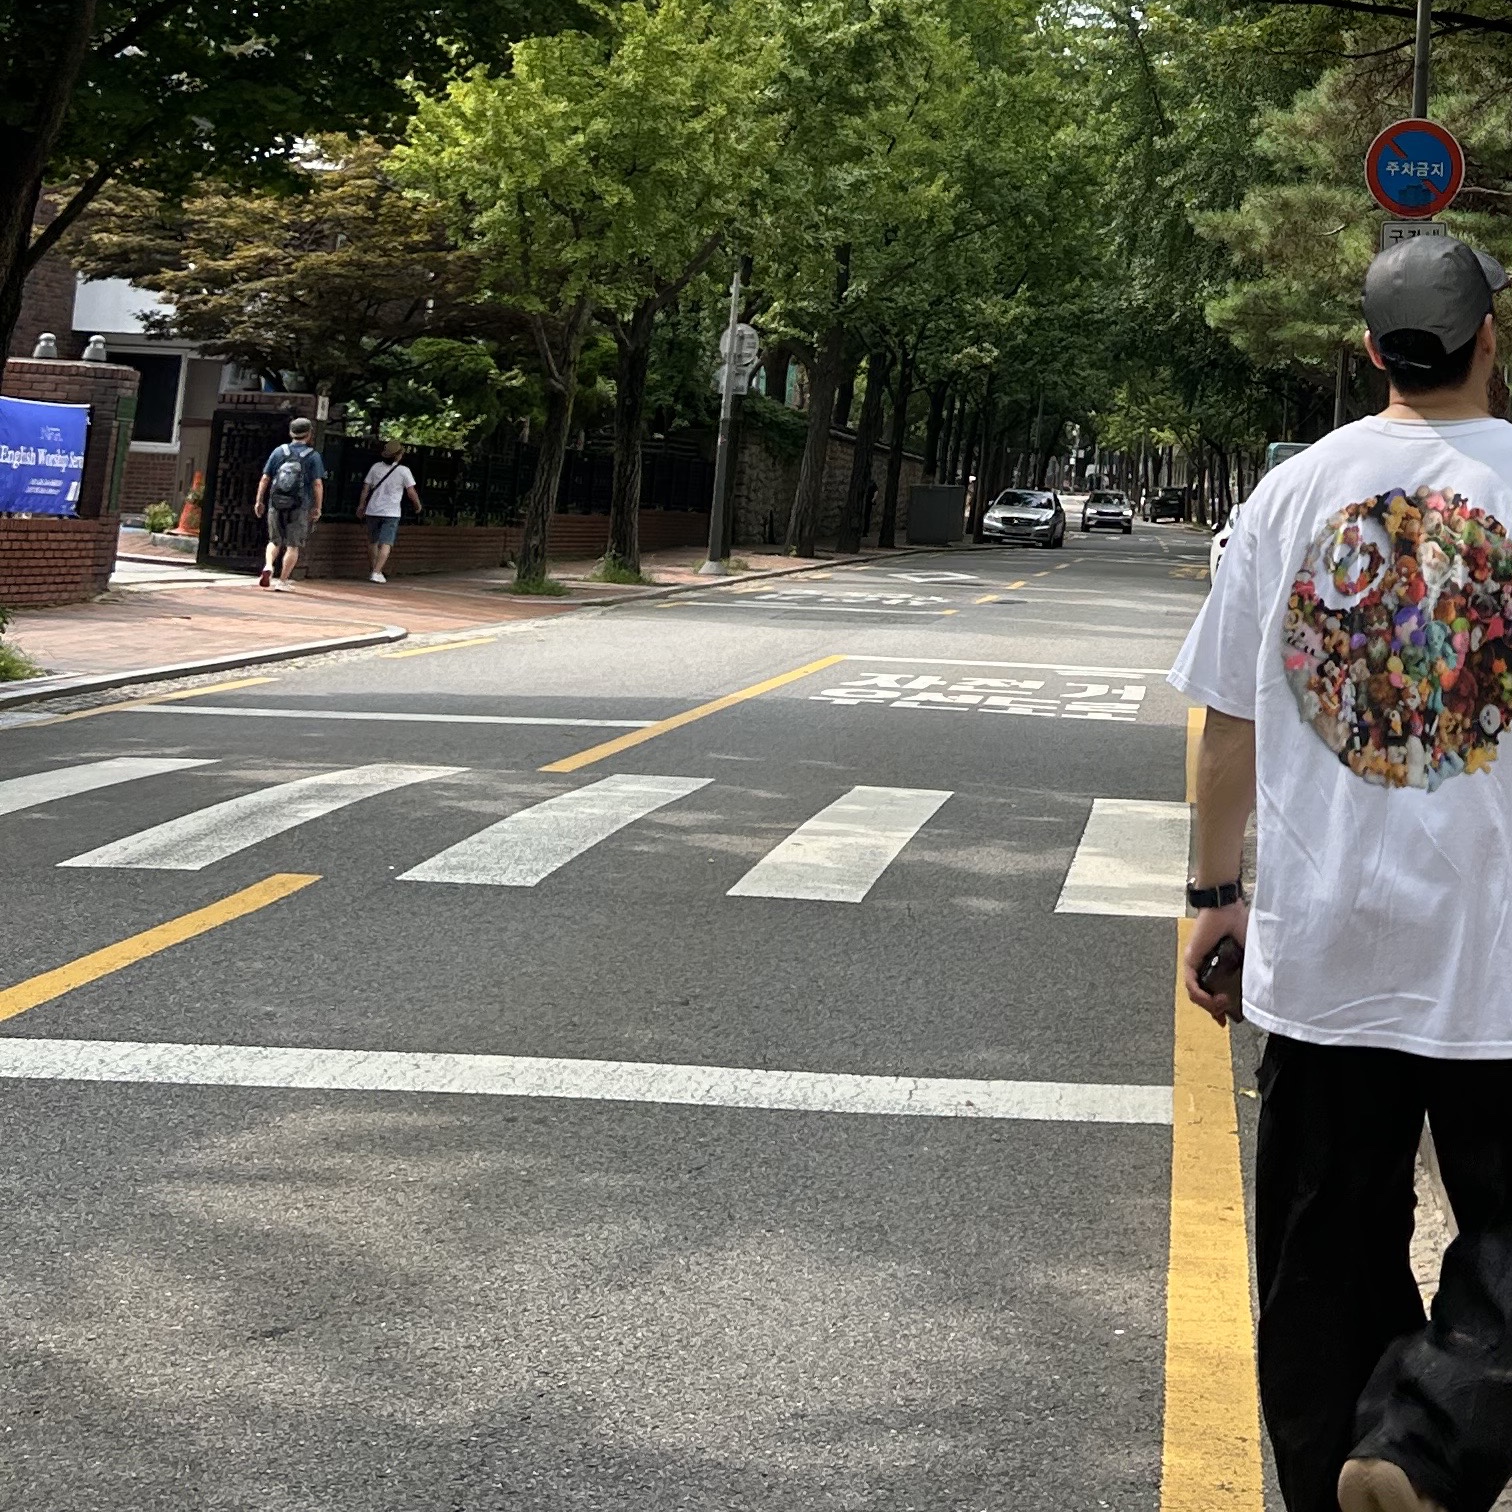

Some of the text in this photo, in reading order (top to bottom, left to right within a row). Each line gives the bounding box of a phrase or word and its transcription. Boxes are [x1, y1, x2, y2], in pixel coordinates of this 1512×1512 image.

[1385, 161, 1444, 178] 주차금지
[0, 444, 36, 469] English
[38, 448, 69, 473] Worship
[838, 672, 1147, 701] 자전거
[808, 687, 1141, 721] 우선도로
